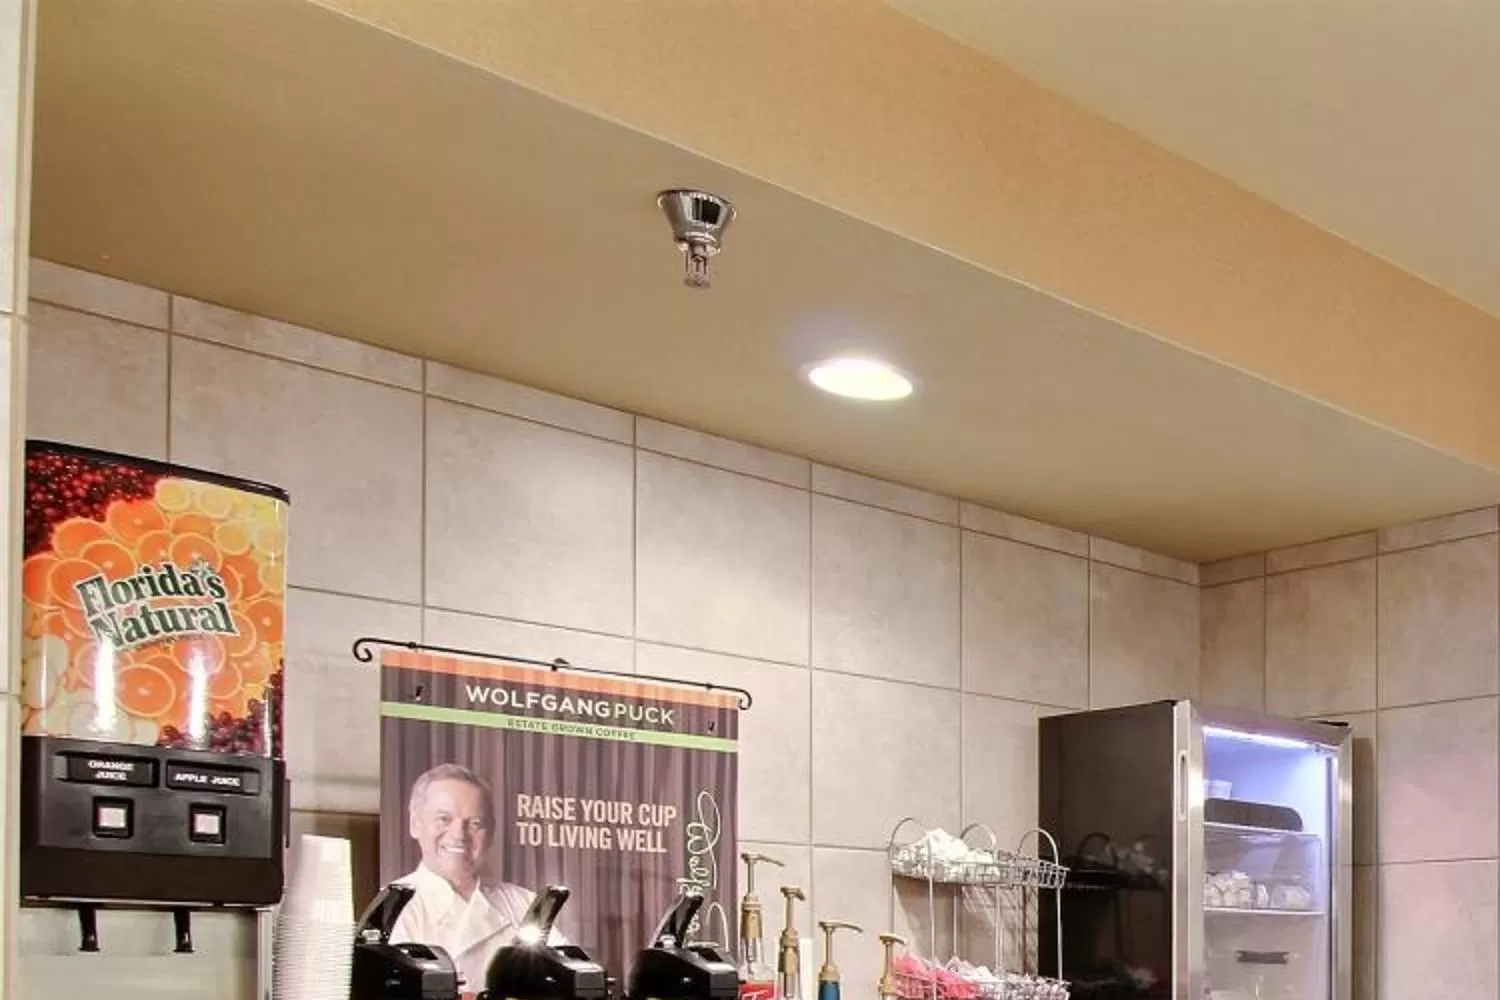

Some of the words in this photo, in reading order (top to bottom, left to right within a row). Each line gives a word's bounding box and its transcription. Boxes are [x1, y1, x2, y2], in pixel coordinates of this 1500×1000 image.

[75, 561, 227, 617] Florida's
[89, 602, 238, 648] Natural
[174, 773, 208, 784] APPLE
[210, 776, 241, 787] JUICE
[517, 794, 577, 820] RAISE
[581, 799, 633, 825] YOUR
[638, 803, 677, 827] CUP
[516, 822, 543, 846] TO
[548, 824, 612, 850] LIVING
[616, 829, 668, 853] WELL
